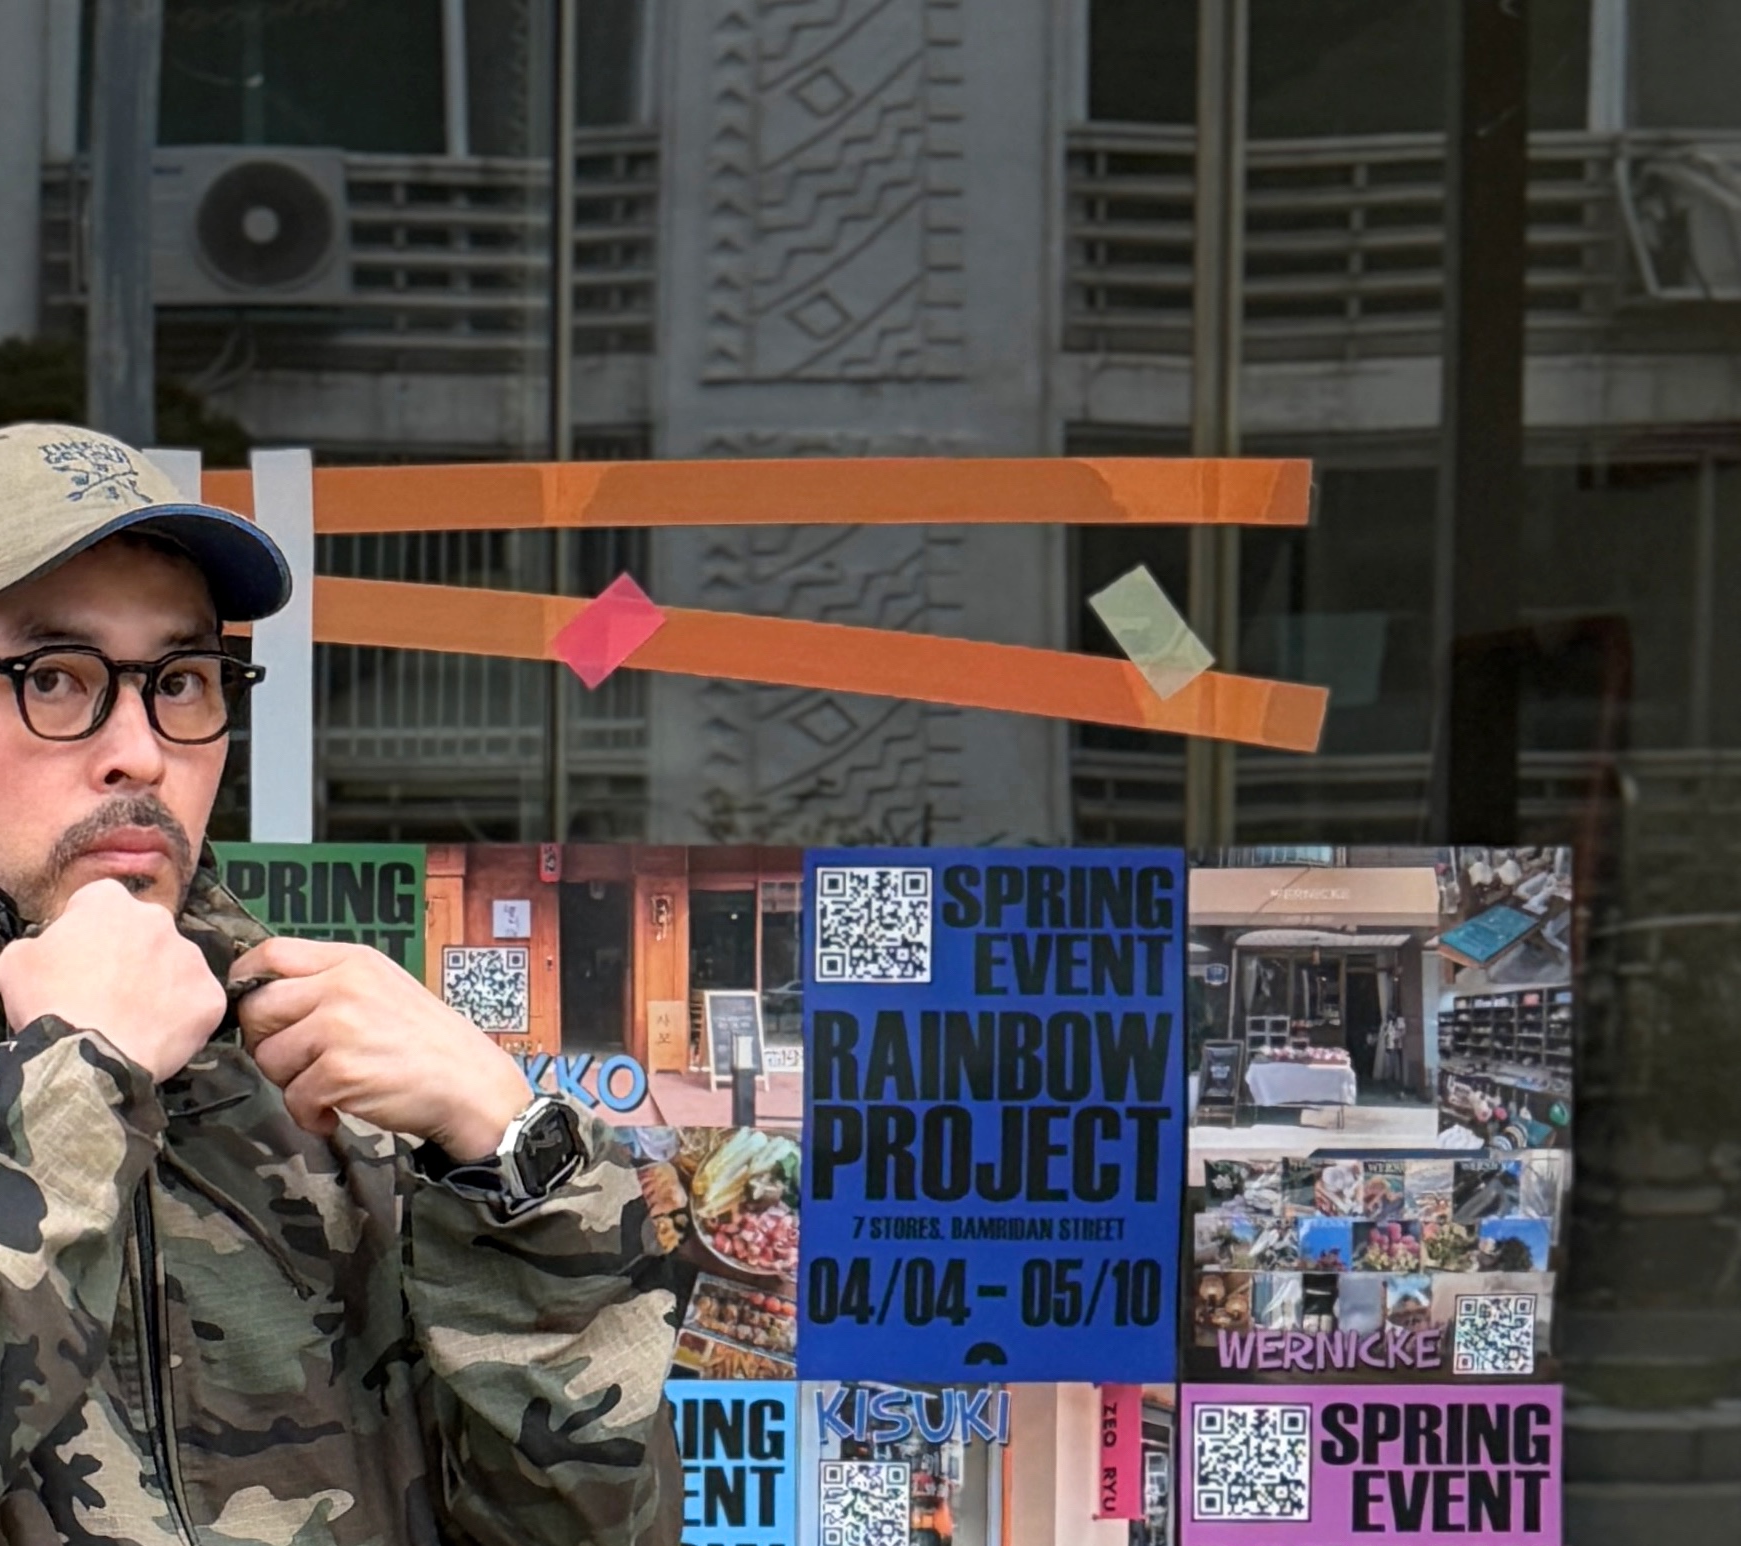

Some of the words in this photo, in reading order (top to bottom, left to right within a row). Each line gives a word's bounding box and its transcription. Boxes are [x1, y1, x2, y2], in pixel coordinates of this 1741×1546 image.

[218, 858, 416, 926] PRING
[942, 864, 1174, 930] SPRING
[974, 933, 1172, 998] EVENT
[811, 1010, 1174, 1102] RAINBOW
[811, 1105, 1171, 1204] PROJECT
[853, 1217, 862, 1240] 7
[951, 1217, 1053, 1242] BAMRIDAN
[1059, 1218, 1126, 1242] STREET
[1020, 1258, 1161, 1329] 05/10
[1216, 1328, 1442, 1371] WERNICKE
[670, 1398, 785, 1460] ING
[814, 1387, 1012, 1445] KISUKI
[1319, 1402, 1551, 1466] SPRING
[1103, 1466, 1117, 1513] RYU
[1351, 1470, 1551, 1534] EVENT
